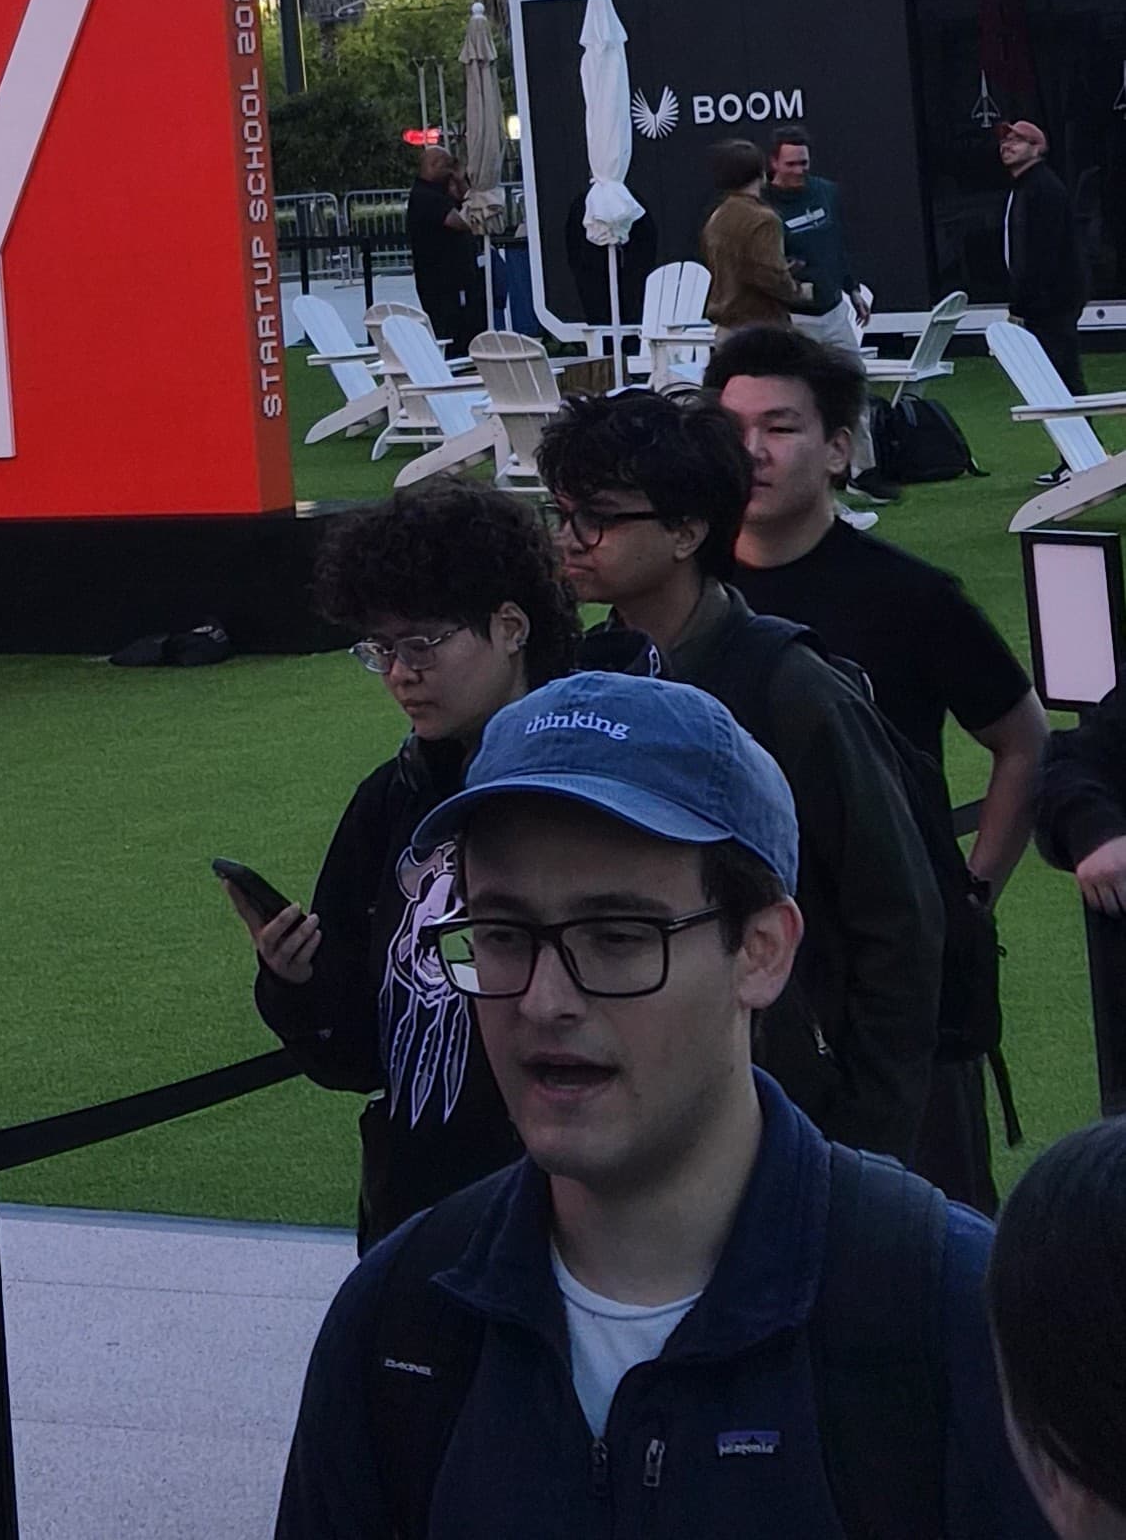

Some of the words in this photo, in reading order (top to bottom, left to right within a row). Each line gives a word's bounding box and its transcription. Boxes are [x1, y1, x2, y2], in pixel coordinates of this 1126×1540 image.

[239, 67, 269, 223] SCHOOL
[692, 88, 804, 125] BOOM
[250, 235, 283, 418] STARTUP
[524, 710, 631, 741] thinking
